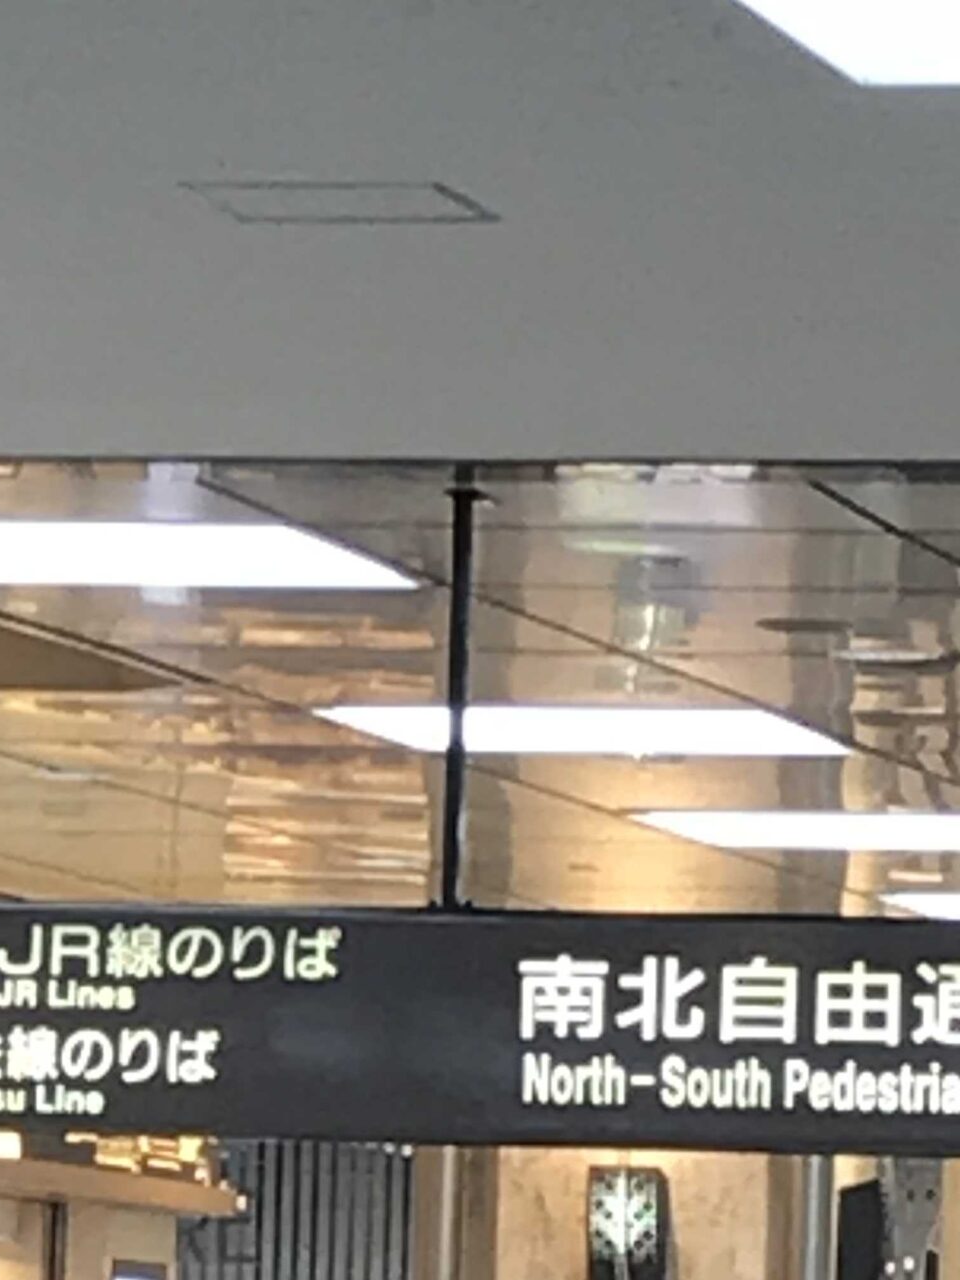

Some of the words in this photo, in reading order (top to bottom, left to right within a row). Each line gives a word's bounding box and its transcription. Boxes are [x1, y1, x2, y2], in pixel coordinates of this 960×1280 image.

[47, 980, 137, 1010] Lines
[34, 1083, 106, 1115] Line
[783, 1057, 960, 1115] Pedestria
